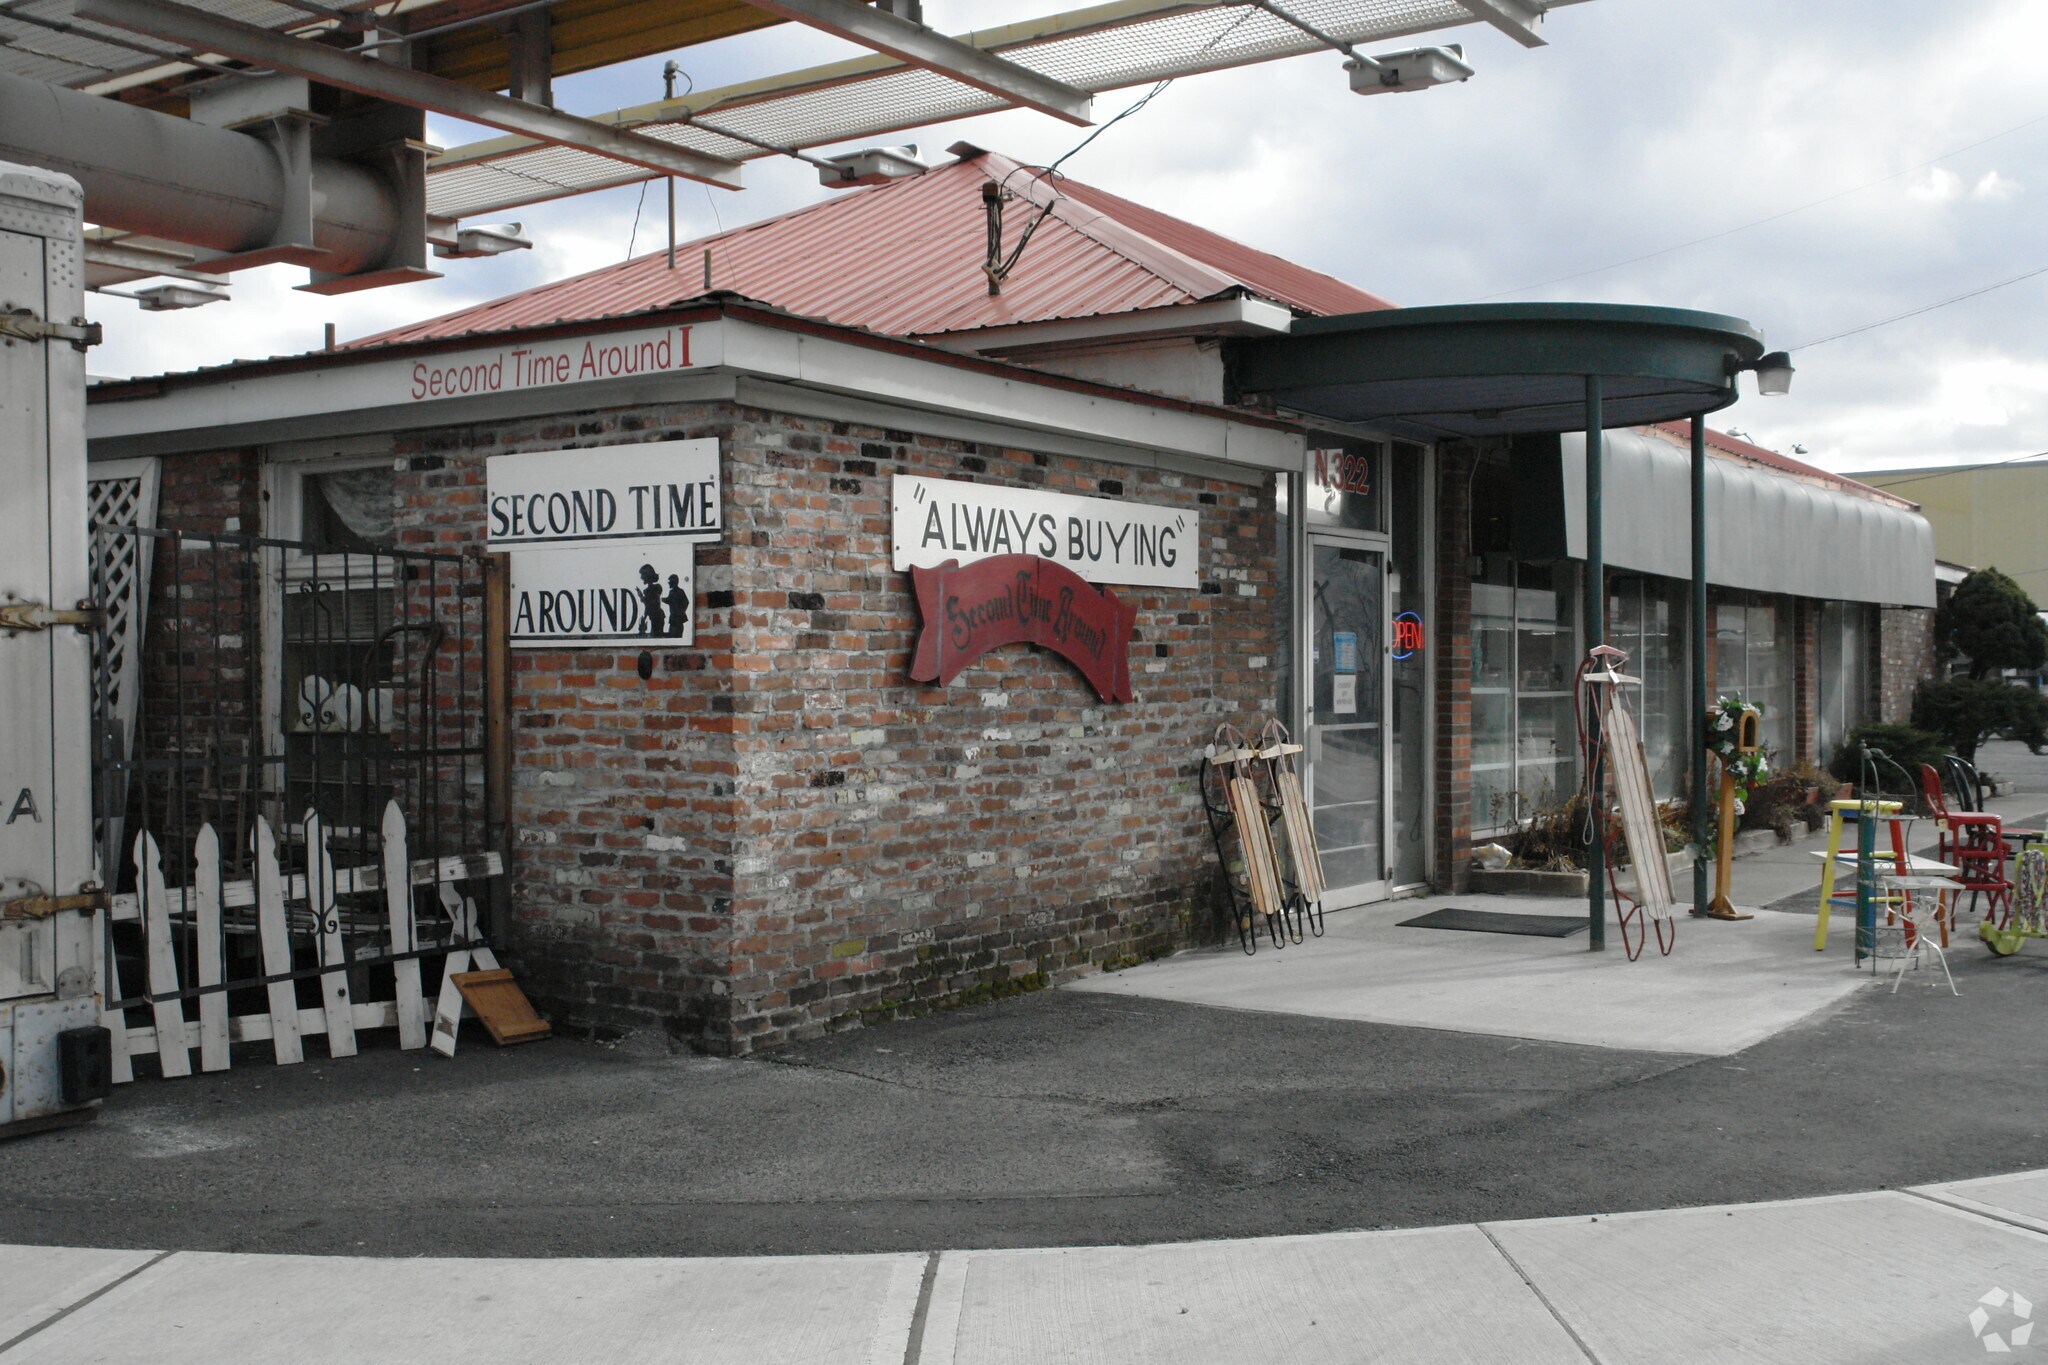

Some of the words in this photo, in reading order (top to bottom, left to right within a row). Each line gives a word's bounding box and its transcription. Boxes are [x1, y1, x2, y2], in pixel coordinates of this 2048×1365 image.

[412, 352, 502, 400] Second
[511, 350, 571, 387] Time
[579, 330, 672, 380] Around
[491, 488, 617, 537] SECOND
[628, 481, 717, 531] TIME
[514, 587, 639, 634] AROUND
[945, 583, 1014, 653] Second
[1015, 569, 1052, 628] Time
[1052, 585, 1107, 664] Around
